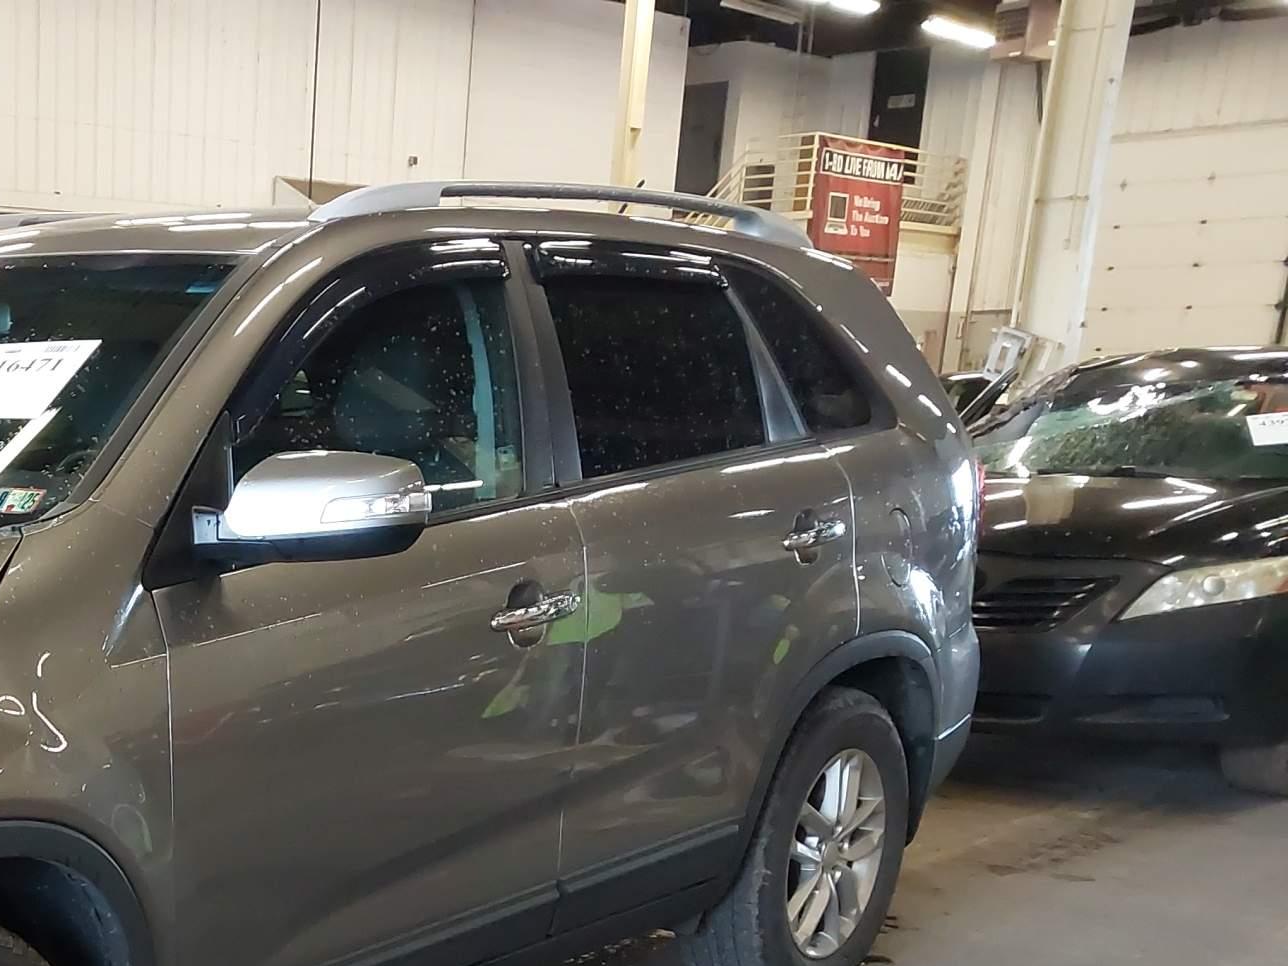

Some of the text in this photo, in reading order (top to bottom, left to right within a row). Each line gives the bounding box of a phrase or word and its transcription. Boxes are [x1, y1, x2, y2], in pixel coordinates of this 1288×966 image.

[844, 155, 863, 176] LIVE
[862, 158, 885, 180] FROM
[863, 211, 889, 225] Auction
